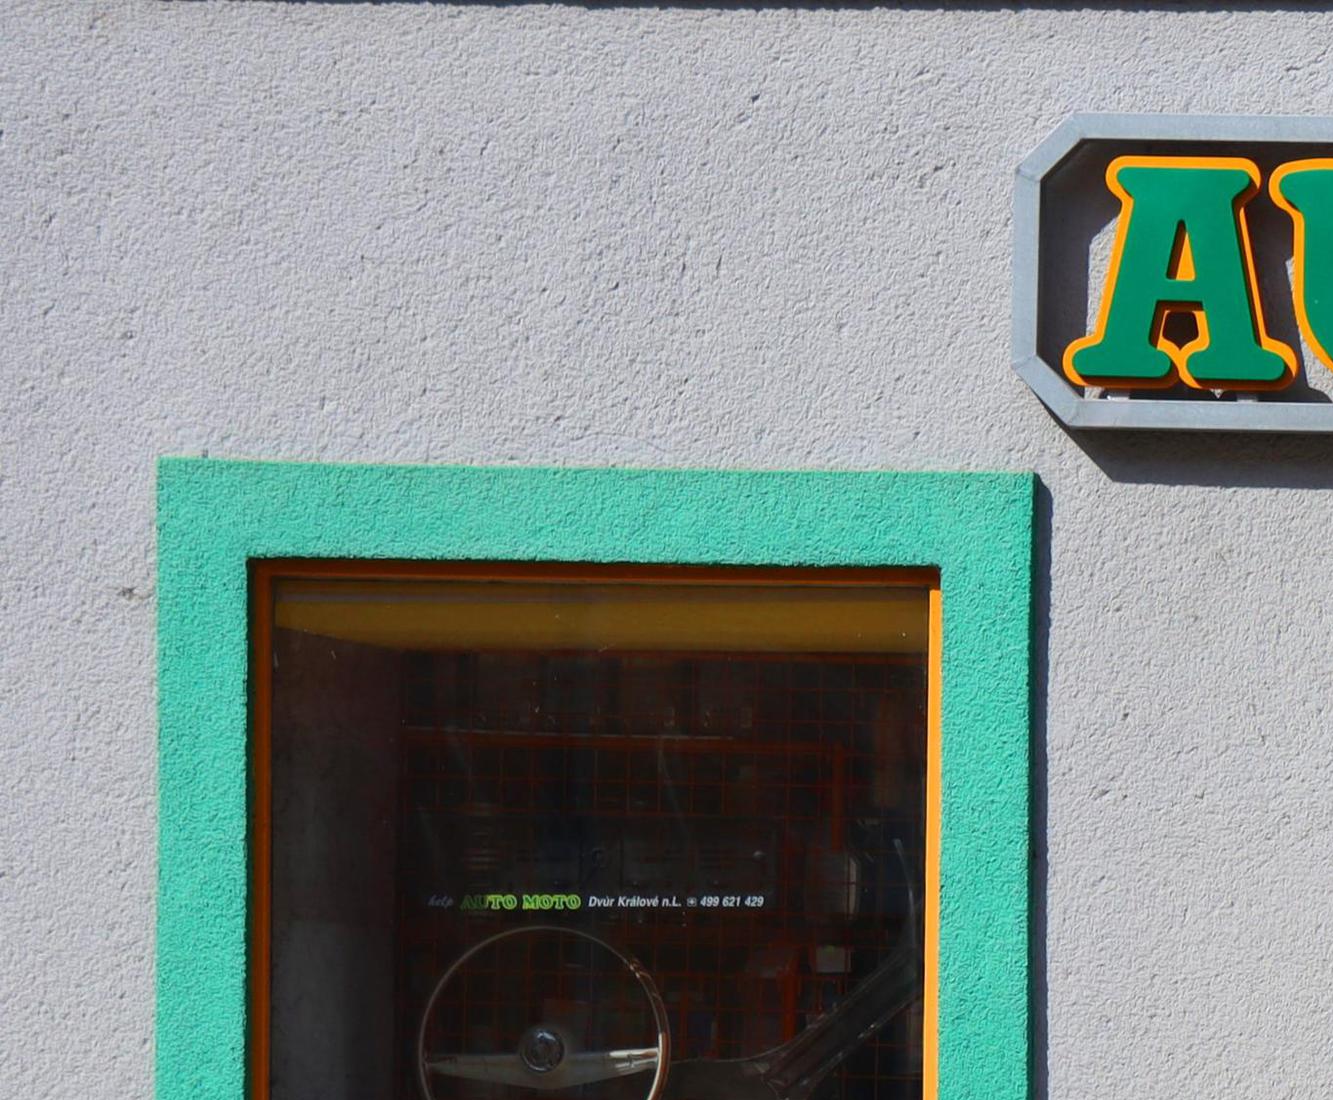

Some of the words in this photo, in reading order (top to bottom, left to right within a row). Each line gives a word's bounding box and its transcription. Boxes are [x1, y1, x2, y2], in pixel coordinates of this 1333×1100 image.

[460, 893, 518, 911] AUTO
[522, 893, 582, 911] MOTO
[699, 895, 720, 908] 499
[722, 895, 741, 908] 621
[744, 895, 765, 908] 429
